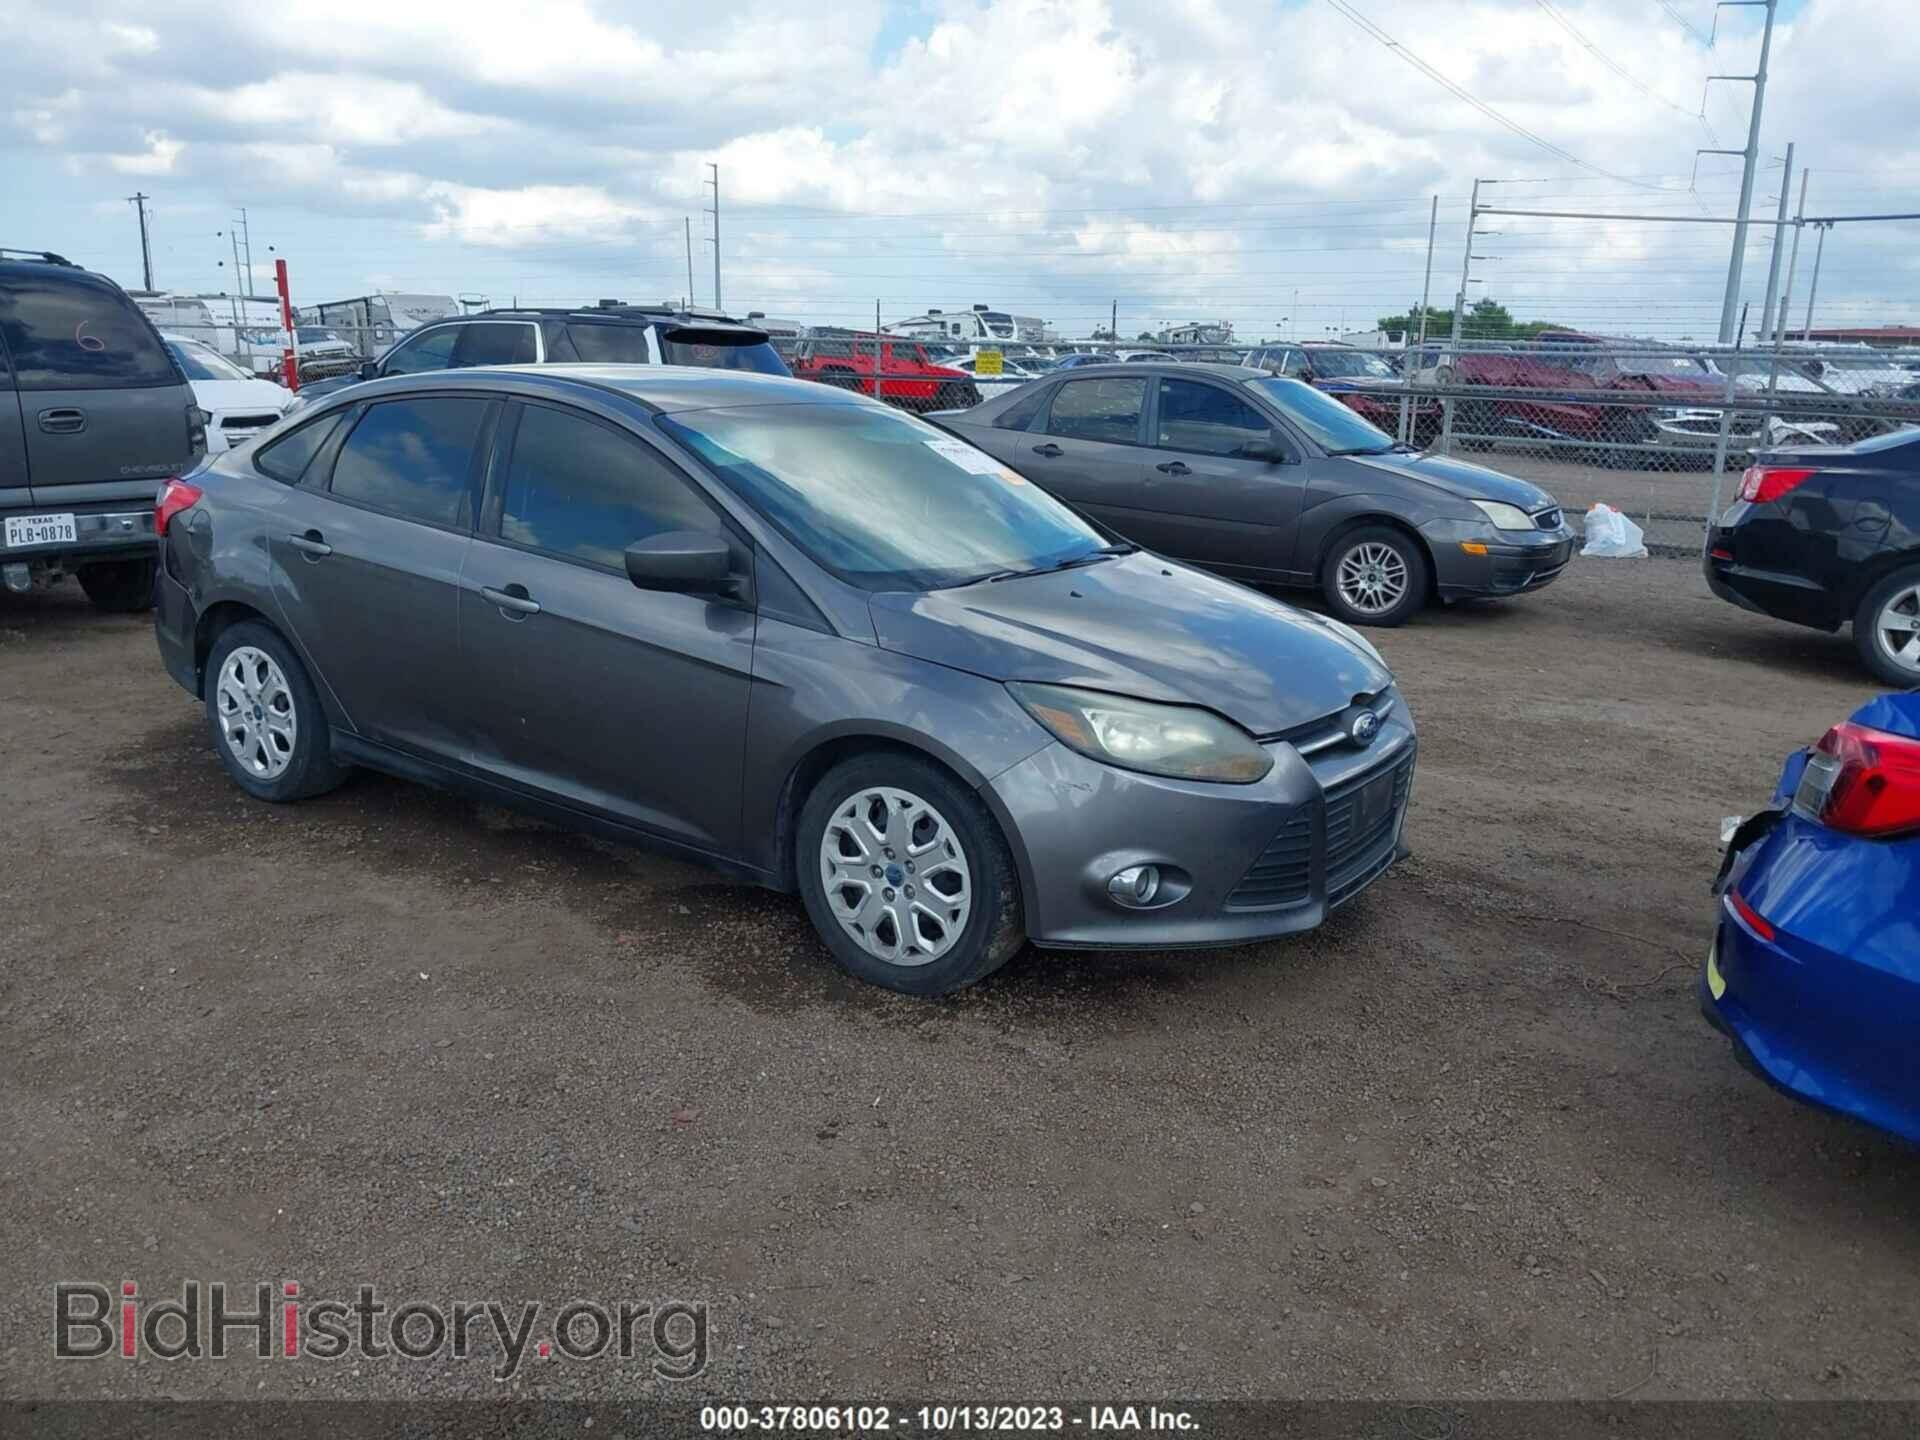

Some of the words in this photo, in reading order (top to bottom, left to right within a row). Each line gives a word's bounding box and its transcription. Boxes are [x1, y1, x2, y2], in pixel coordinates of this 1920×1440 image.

[73, 319, 105, 352] 6
[27, 516, 54, 525] TEXAS
[10, 524, 73, 545] PLB-0878
